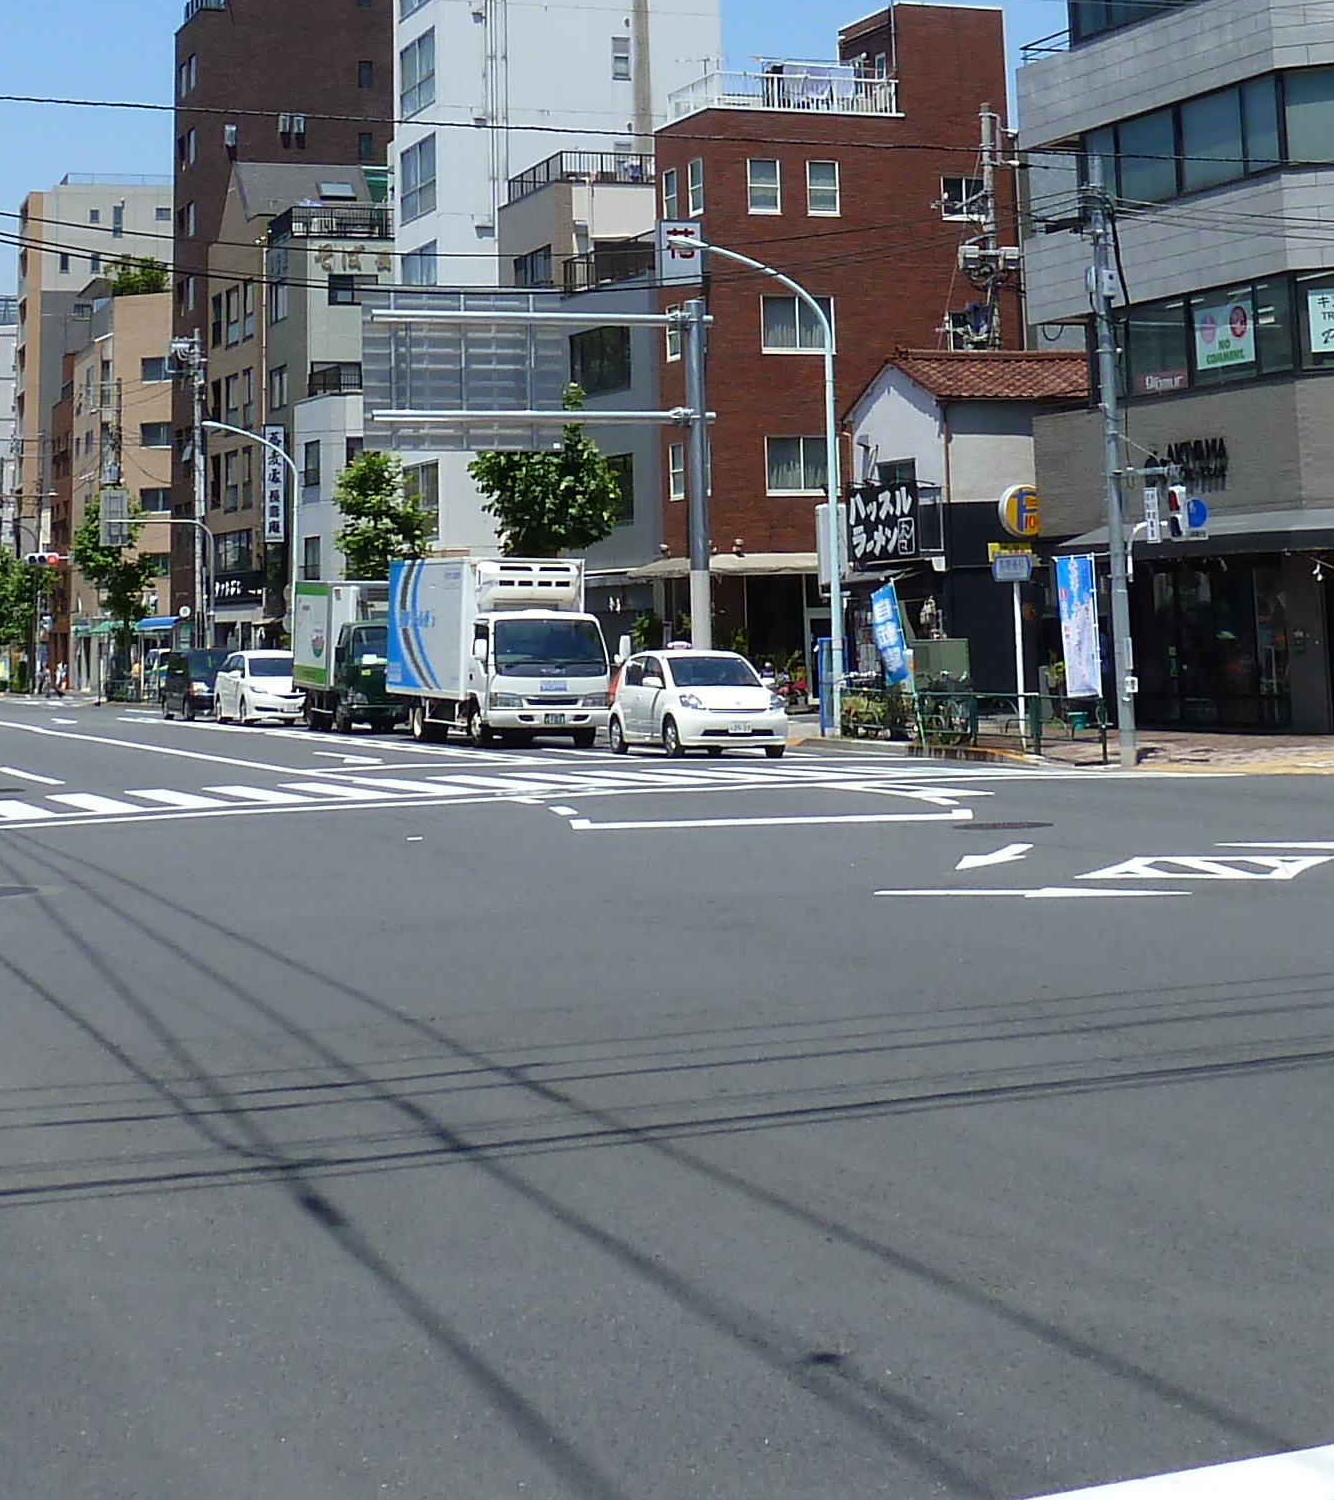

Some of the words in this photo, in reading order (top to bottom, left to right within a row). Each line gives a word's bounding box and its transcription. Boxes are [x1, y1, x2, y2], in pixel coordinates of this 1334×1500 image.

[848, 486, 913, 526] ハッスル
[851, 523, 899, 559] ラーメン
